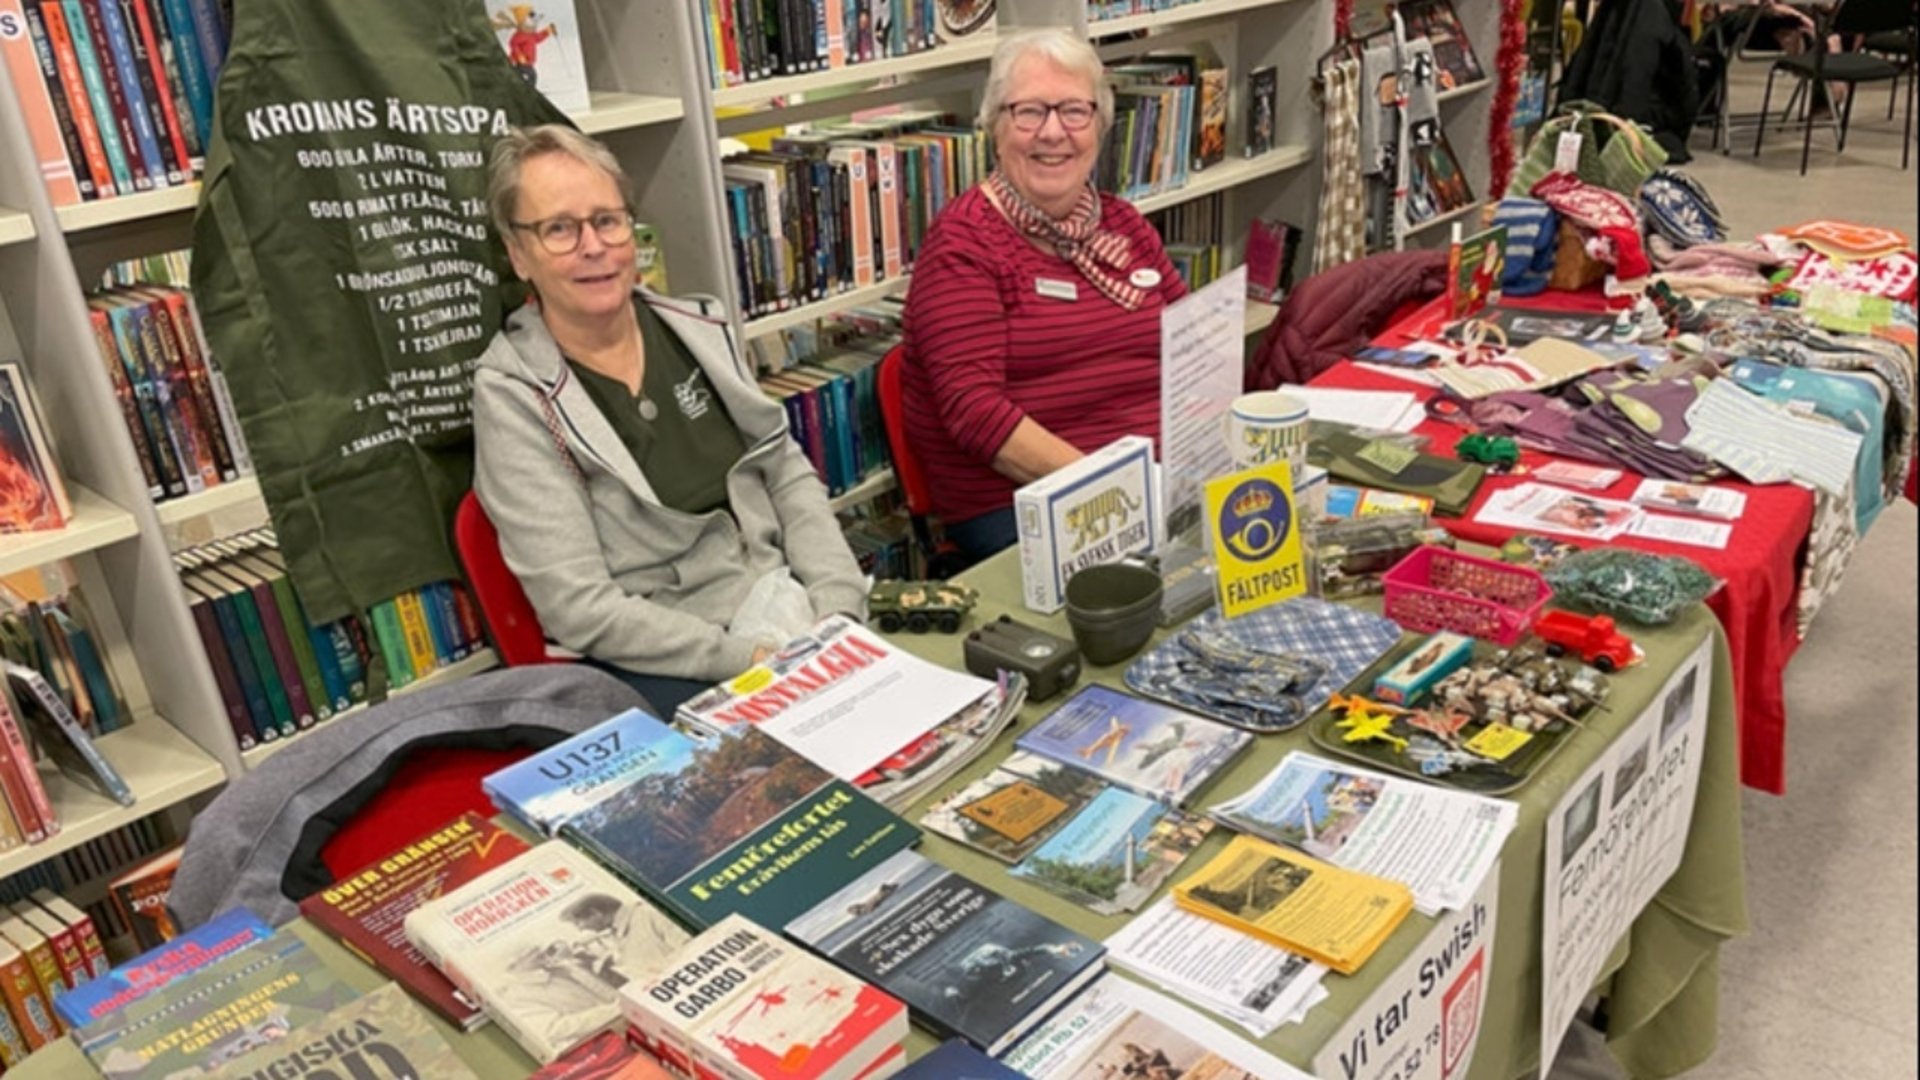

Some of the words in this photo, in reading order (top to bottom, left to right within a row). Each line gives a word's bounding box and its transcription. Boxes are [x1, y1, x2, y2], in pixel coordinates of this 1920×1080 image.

[381, 168, 446, 190] VATTEN
[1226, 563, 1301, 607] FÄLTPOST
[539, 731, 625, 783] U137
[689, 787, 853, 902] Femörefortet
[1559, 733, 1692, 904] Femörefortet
[321, 868, 384, 906] ÖVER
[379, 820, 475, 875] GRÄNSEN
[452, 876, 540, 928] OPERATION
[648, 928, 759, 1005] OPERATION
[672, 965, 748, 1020] GARBO
[1339, 1029, 1368, 1080] Vi
[1374, 989, 1413, 1047] tar
[1419, 903, 1487, 998] Swish
